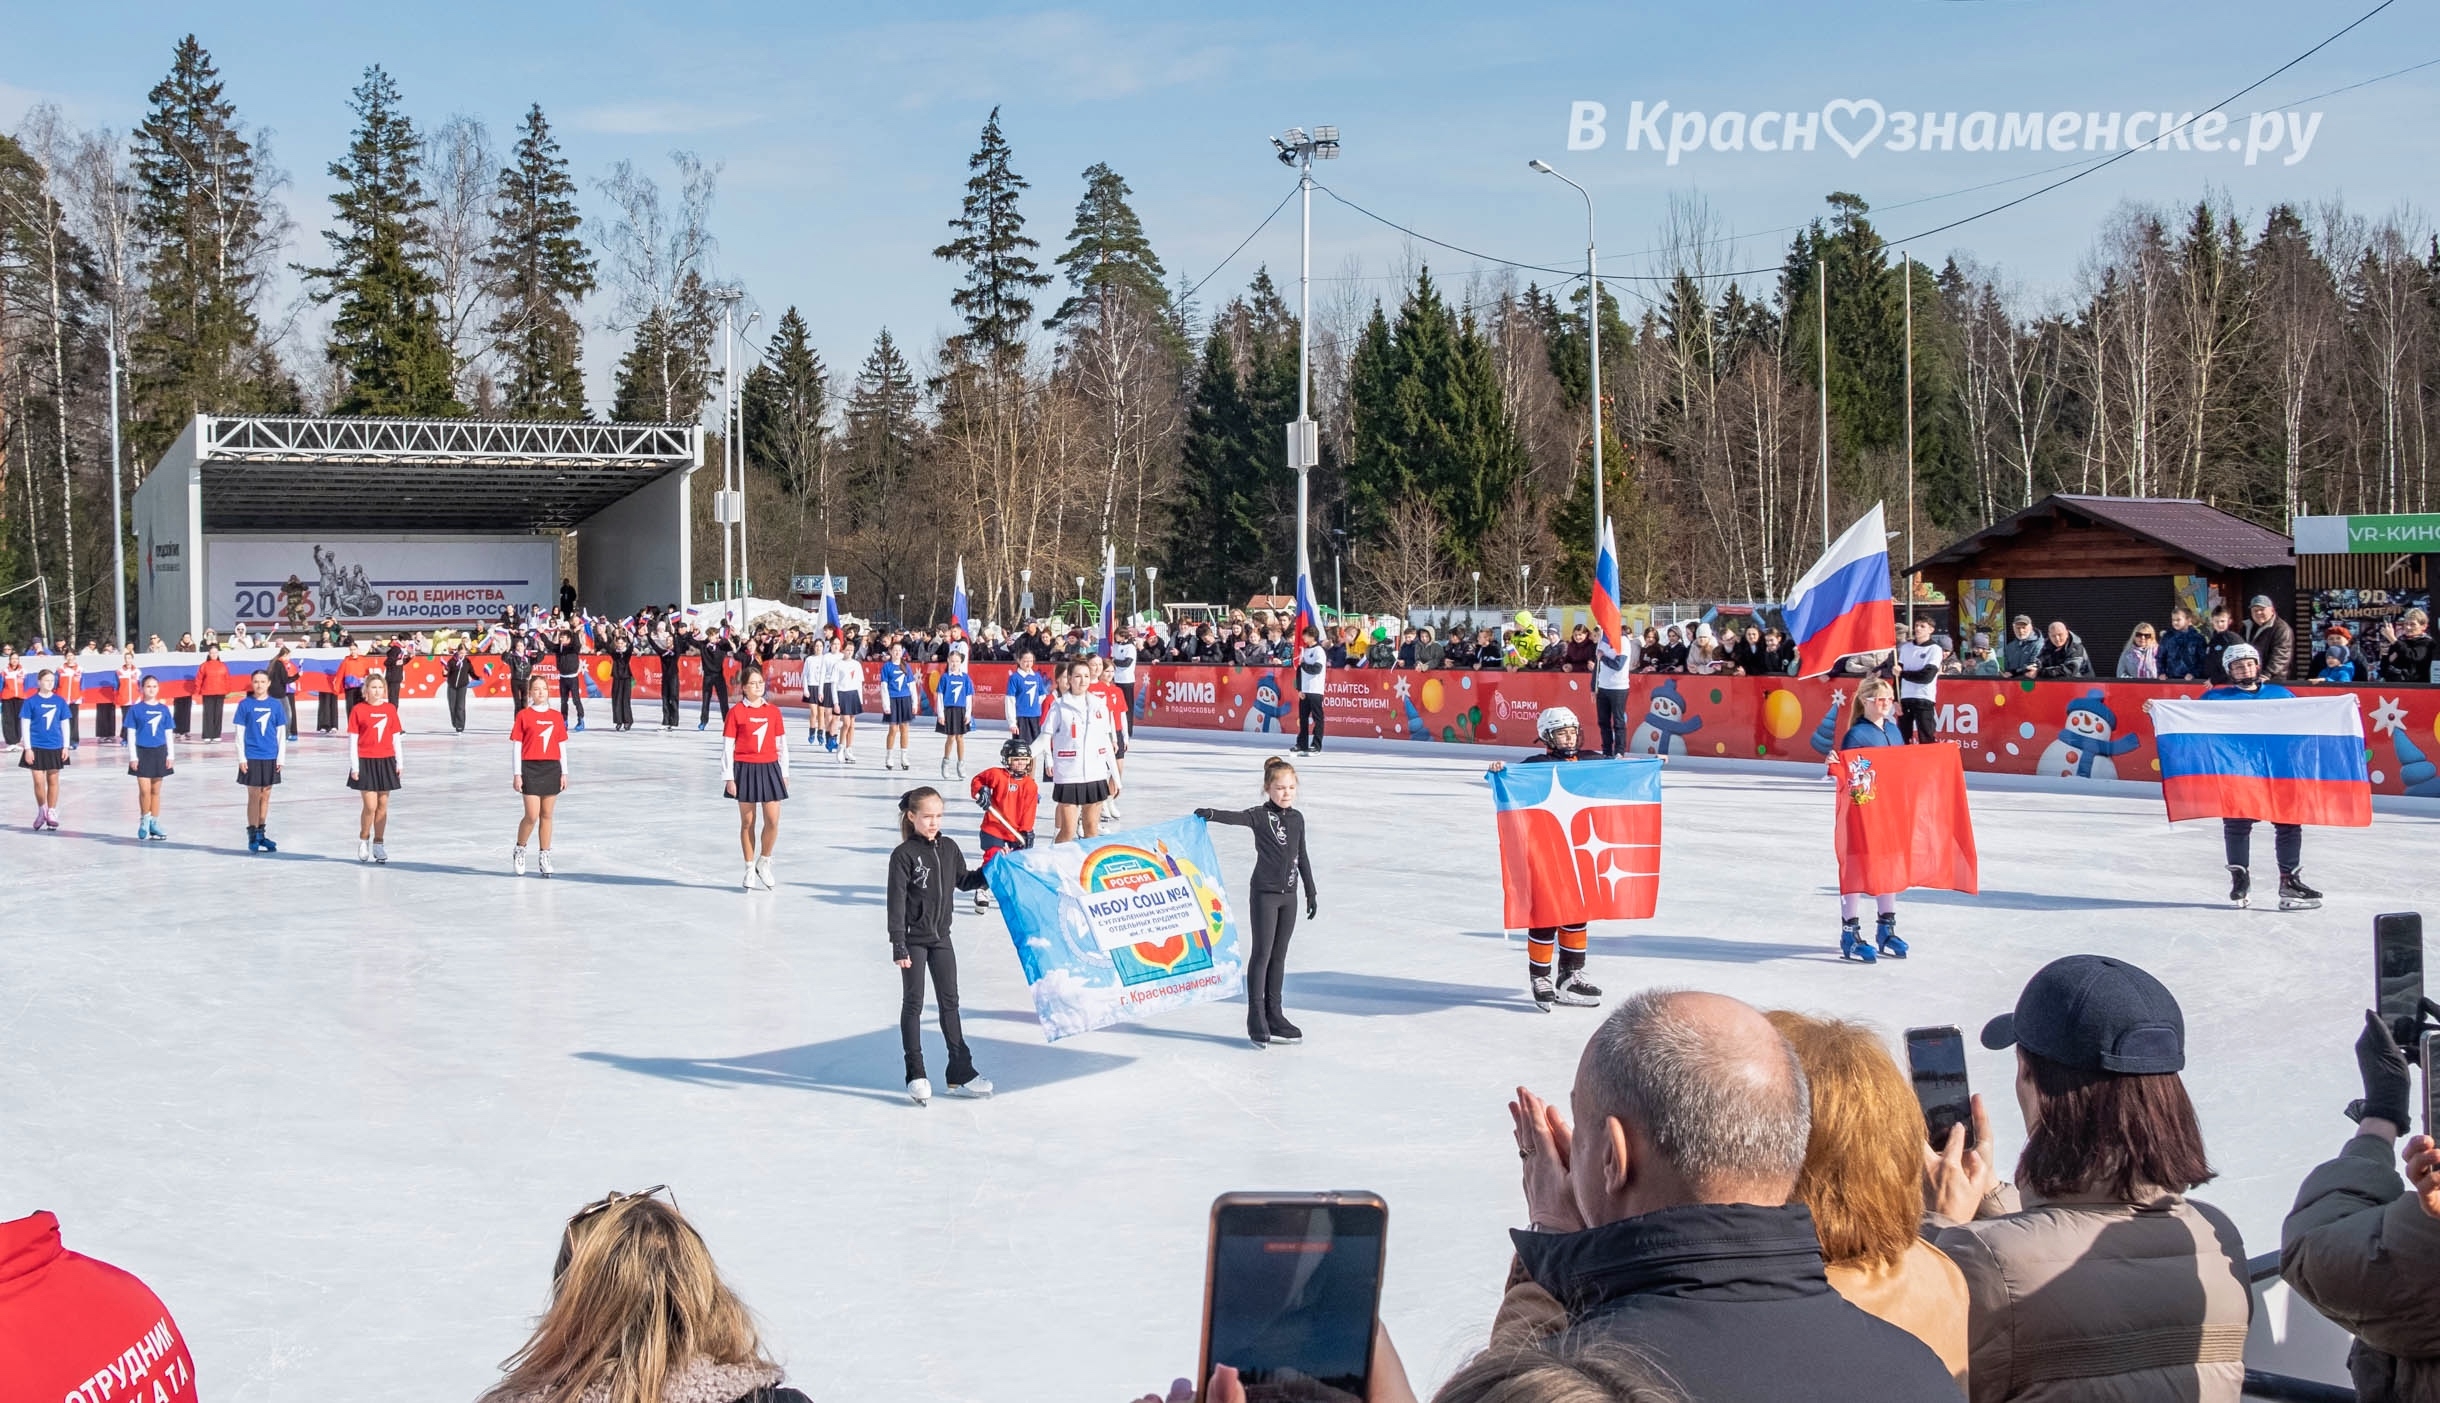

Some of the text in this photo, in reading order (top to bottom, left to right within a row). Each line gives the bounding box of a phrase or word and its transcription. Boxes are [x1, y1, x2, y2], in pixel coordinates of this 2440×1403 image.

[387, 588, 505, 602] ГОД ЕДИНСТВА
[387, 604, 462, 617] НАРОДОВ
[1322, 697, 1389, 709] ОВОЛЬСТВИЕМ!
[1511, 701, 1538, 710] ПАРКИ
[1109, 873, 1152, 888] РОССИЯ
[1088, 886, 1190, 918] МБОУ СОШ №4
[1108, 911, 1190, 934] ОТДЕЛЬНЫХ ПРЕДМЕТОВ
[1129, 974, 1222, 1004] Краснознаменск
